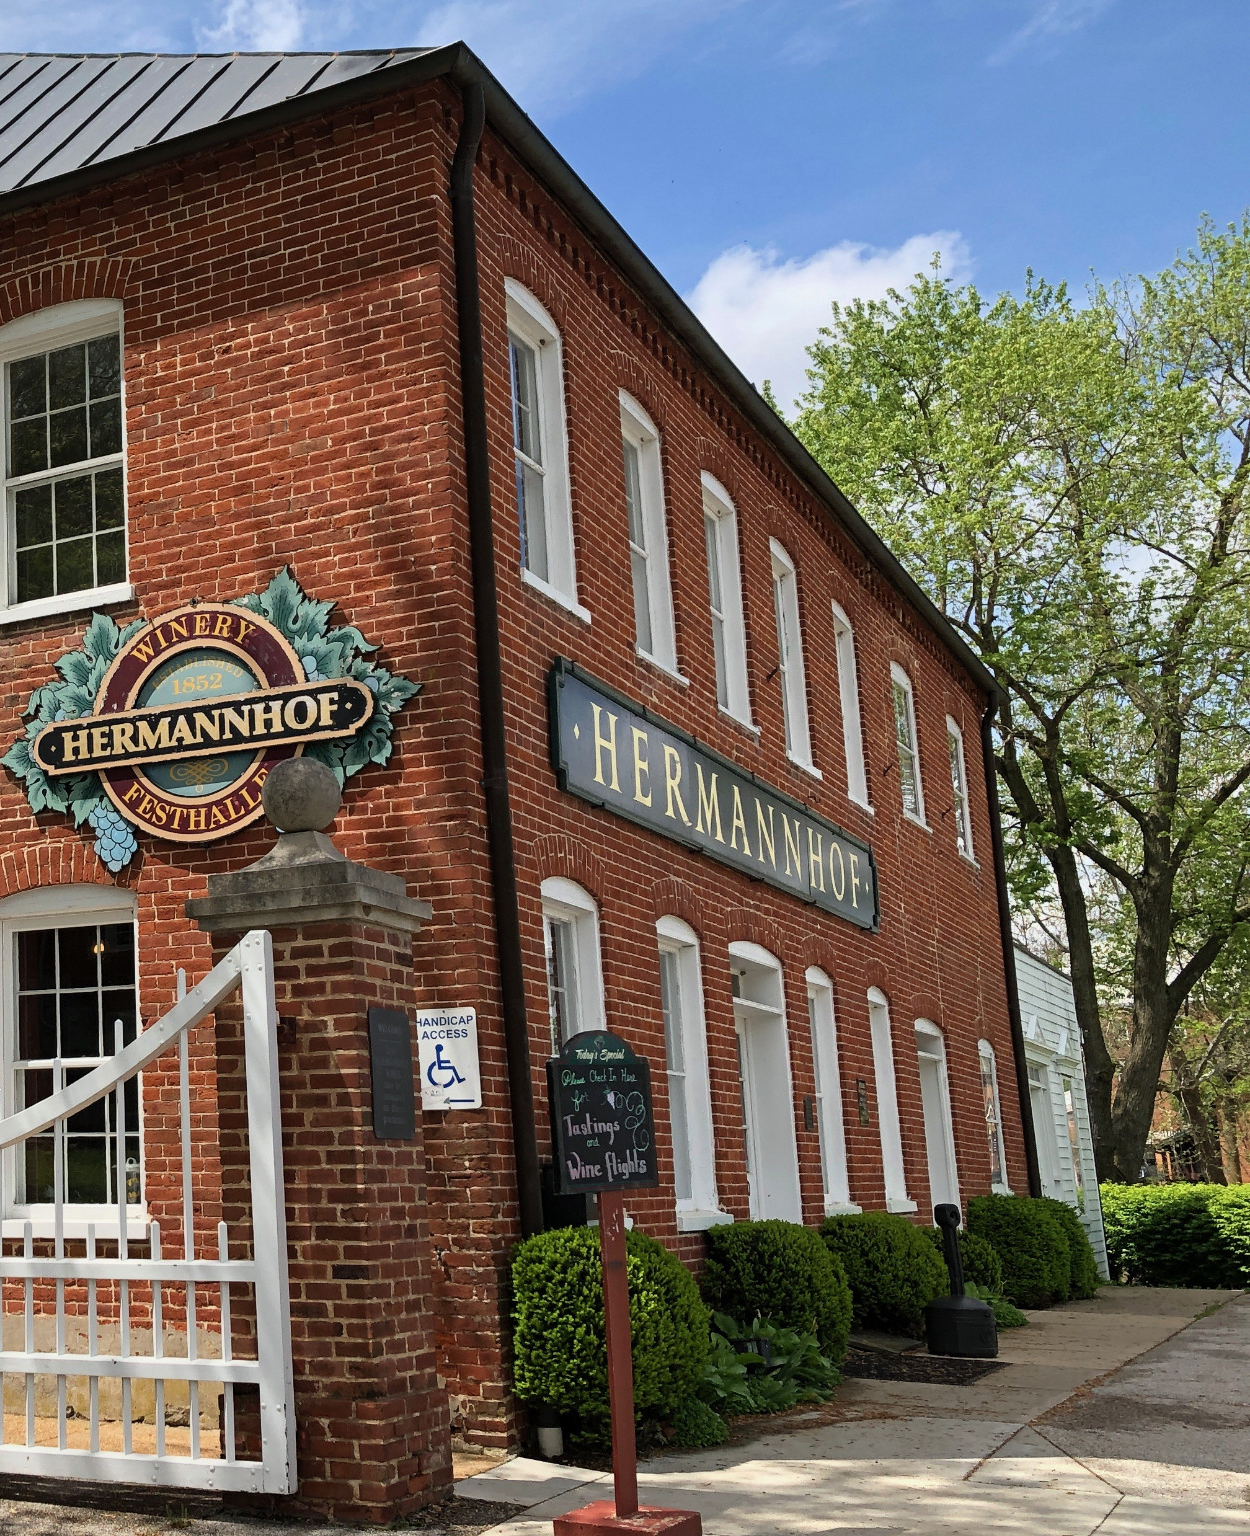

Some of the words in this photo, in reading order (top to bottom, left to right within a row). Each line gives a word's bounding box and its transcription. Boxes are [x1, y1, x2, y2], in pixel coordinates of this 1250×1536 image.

[130, 614, 256, 662] WINERY
[152, 655, 244, 690] ESTABLISHED
[172, 672, 223, 695] 1852
[61, 692, 339, 763] HERMANNHOF
[590, 701, 860, 909] HERMANNHOF
[422, 1028, 468, 1040] ACCESS
[576, 1049, 598, 1064] Today's
[599, 1048, 625, 1062] Special
[561, 1069, 586, 1086] Please
[589, 1069, 607, 1083] Check
[608, 1067, 617, 1082] In
[621, 1067, 638, 1082] Here
[571, 1089, 590, 1111] for
[563, 1112, 620, 1145] Tastings
[586, 1137, 599, 1148] and
[567, 1151, 602, 1180] Wine
